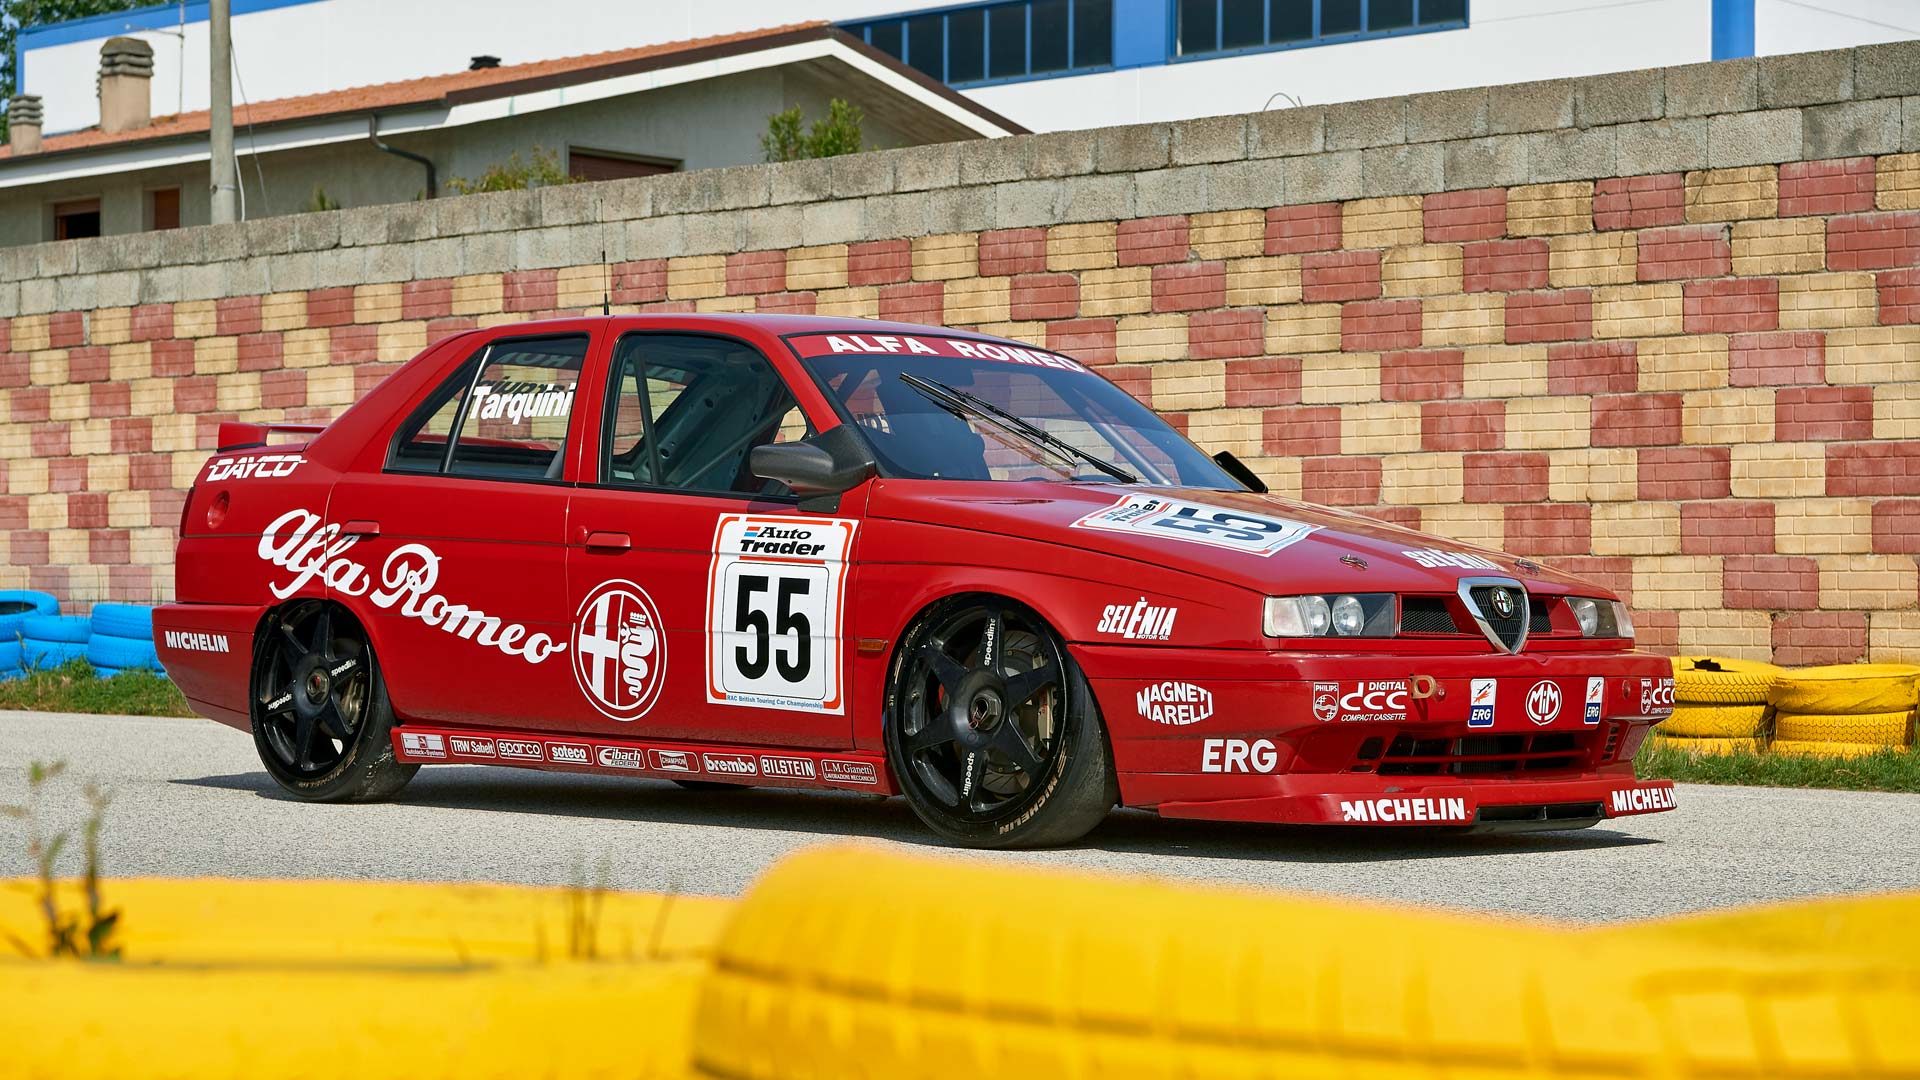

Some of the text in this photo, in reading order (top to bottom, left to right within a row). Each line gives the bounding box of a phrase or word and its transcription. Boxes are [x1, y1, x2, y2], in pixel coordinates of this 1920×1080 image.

[826, 336, 1085, 373] ALFA ROMEO
[470, 383, 577, 425] Tarquini
[206, 455, 308, 482] DAYCO
[757, 526, 812, 540] Auto
[740, 540, 825, 556] Trader
[257, 508, 567, 664] Alfa Romeo
[735, 574, 811, 683] 55
[165, 631, 229, 652] MICHELIN
[1315, 684, 1338, 692] PHILIPS
[1368, 681, 1407, 691] DIGITAL
[756, 697, 775, 705] Touring
[786, 700, 823, 709] Championship
[1136, 682, 1213, 718] MAGNETI
[1340, 682, 1408, 711] dcc
[1136, 692, 1213, 726] MARELLI
[1471, 709, 1491, 721] ERG
[1587, 706, 1599, 717] ERG
[1341, 713, 1407, 722] COMPACT CASSETTE
[451, 739, 495, 755] TRW Sabelt
[499, 742, 541, 755] sparco
[552, 747, 587, 760] soteco
[599, 748, 640, 763] Eibach
[662, 757, 686, 765] CHAMPION
[1202, 738, 1278, 773] ERG
[704, 756, 756, 773] brembo
[761, 759, 815, 778] BILSTEIN
[1340, 798, 1465, 822] MICHELIN
